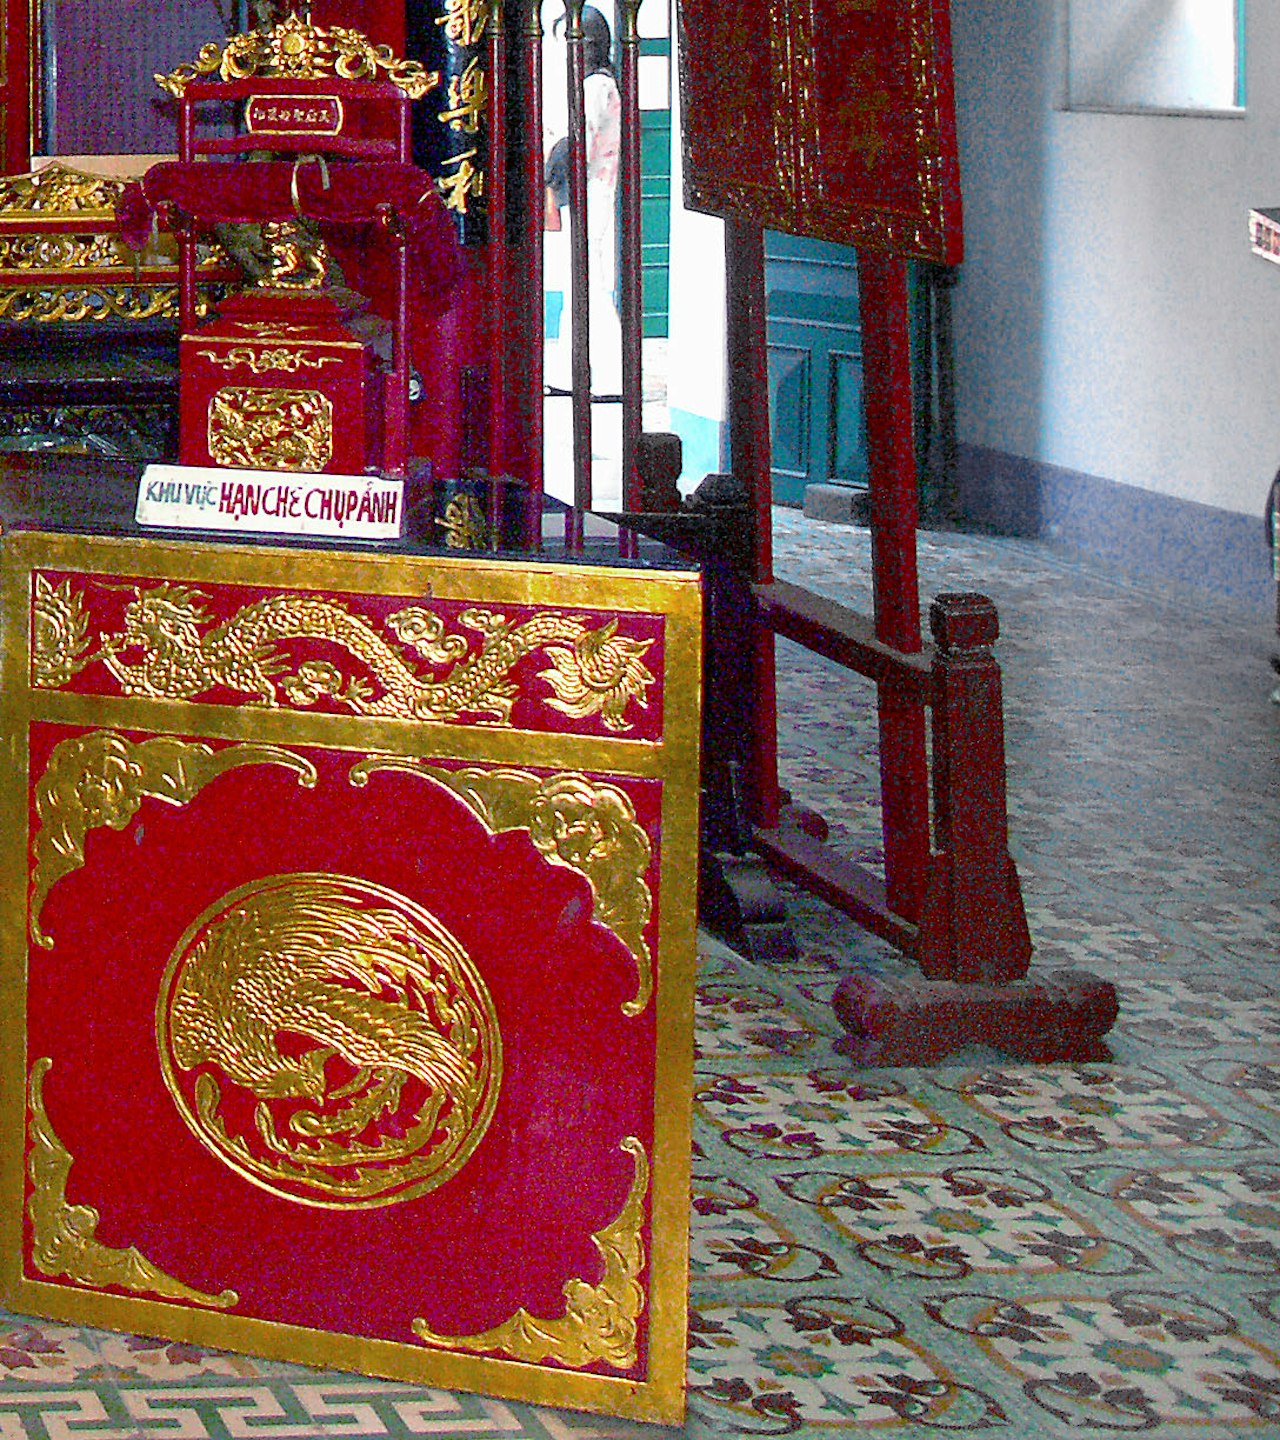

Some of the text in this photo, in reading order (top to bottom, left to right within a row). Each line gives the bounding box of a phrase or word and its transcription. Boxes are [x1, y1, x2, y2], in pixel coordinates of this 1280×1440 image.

[218, 482, 262, 521] HẠN
[304, 488, 358, 529] CHỤP
[356, 481, 400, 524] ẢNH
